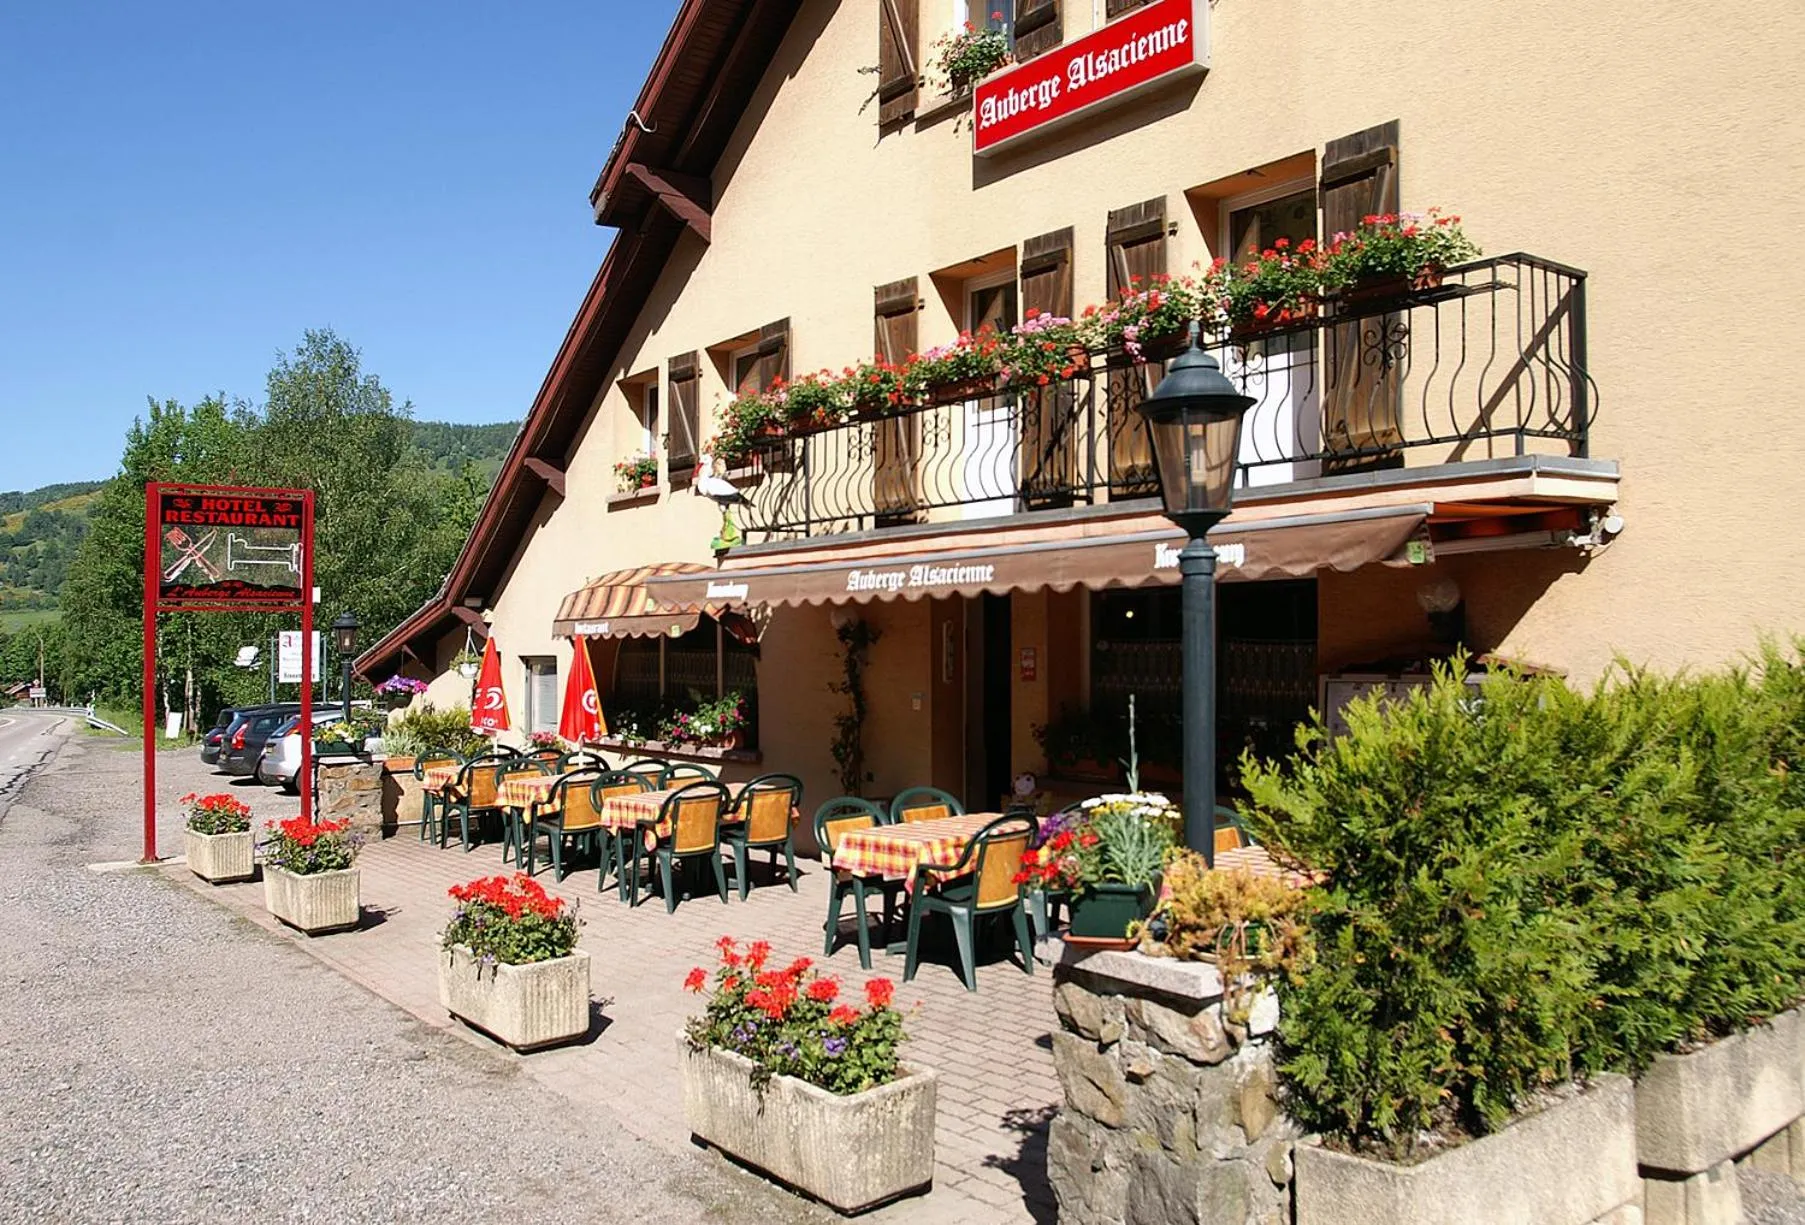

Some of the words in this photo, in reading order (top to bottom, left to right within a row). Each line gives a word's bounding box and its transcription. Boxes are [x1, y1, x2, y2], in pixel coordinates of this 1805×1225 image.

[979, 74, 1061, 130] Auberge
[1067, 18, 1188, 93] Alsacienne
[202, 500, 267, 512] HOTEL
[165, 510, 299, 526] RESTAURANT
[847, 568, 905, 592] Auberge
[908, 563, 995, 587] Alsacienne
